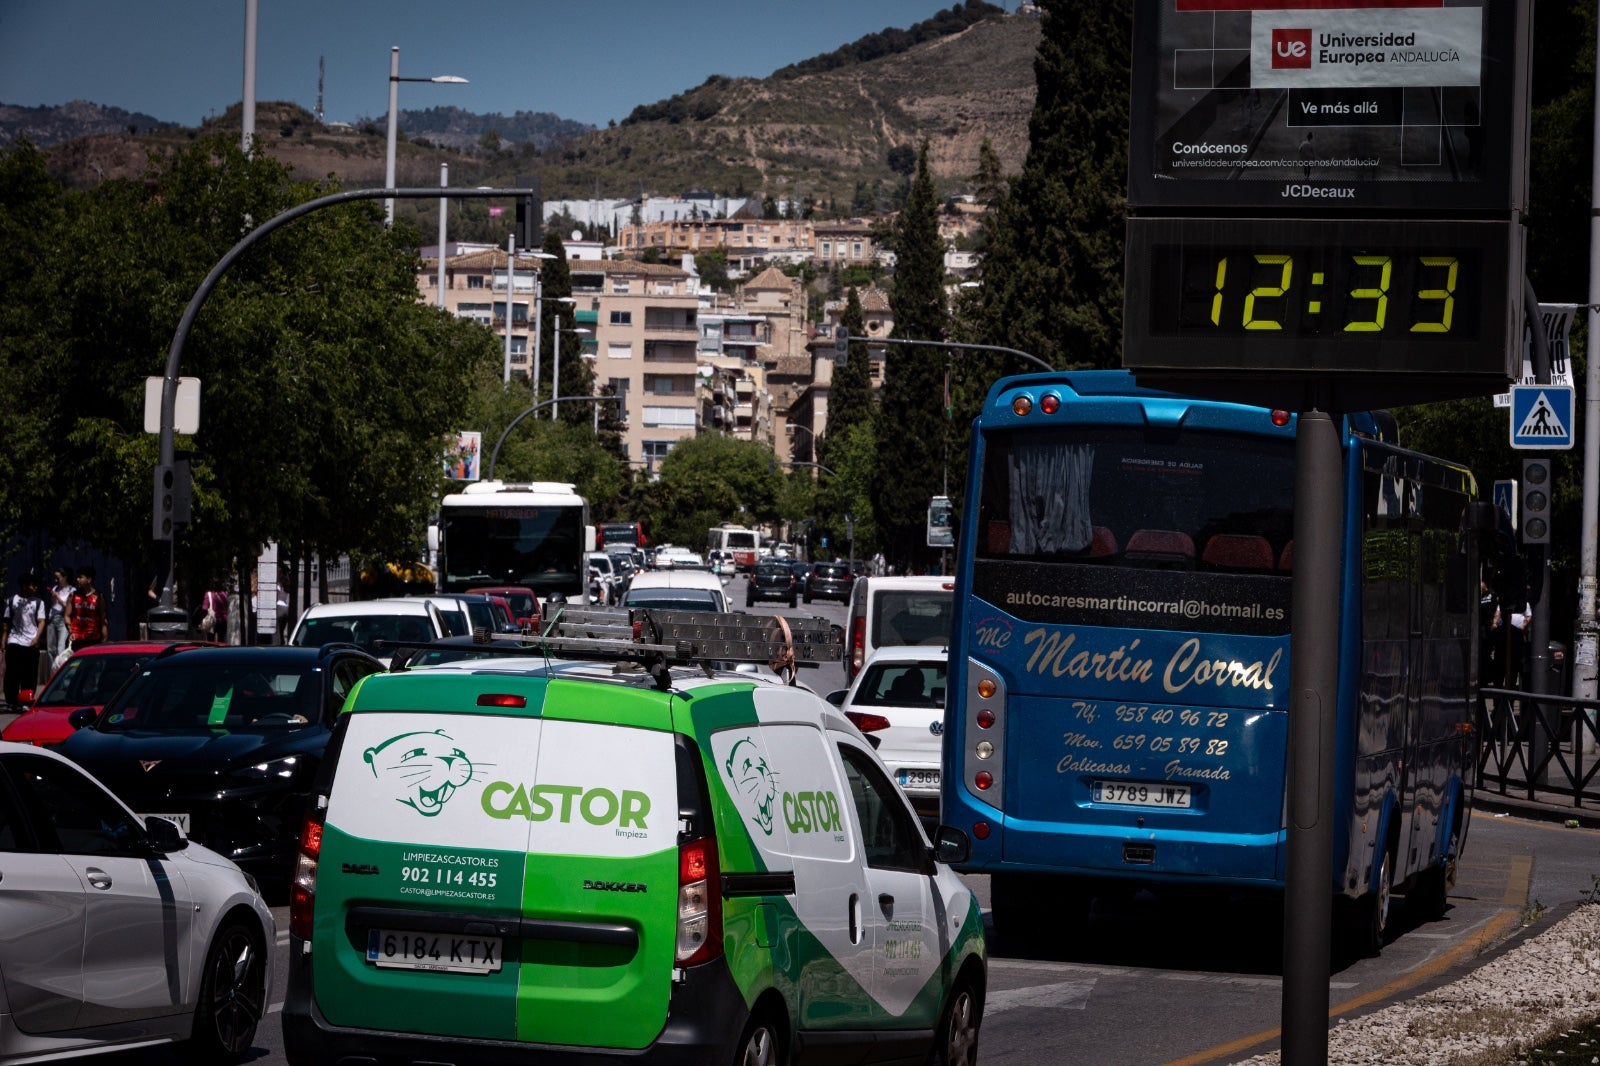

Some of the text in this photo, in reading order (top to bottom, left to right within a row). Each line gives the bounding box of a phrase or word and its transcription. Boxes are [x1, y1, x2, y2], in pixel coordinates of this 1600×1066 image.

[1277, 40, 1307, 58] ue
[1319, 32, 1416, 48] Universidad
[1319, 49, 1460, 67] Europea ANDALUCÍA
[1301, 100, 1378, 114] Ve más allá
[1172, 141, 1248, 155] Conócenos
[1280, 184, 1355, 198] JCDecaux
[1210, 254, 1458, 332] 12:33
[1006, 590, 1285, 620] autocaresmartincorral@hotmail.es
[1023, 628, 1283, 693] Martín Corral
[1115, 705, 1148, 723] 958
[1151, 709, 1174, 725] 40
[1180, 709, 1200, 726] 96
[1205, 712, 1228, 728] 72
[1113, 734, 1146, 751] 659
[1150, 736, 1171, 752] 05
[1177, 737, 1200, 754] 89
[1205, 739, 1228, 756] 82
[1056, 755, 1131, 775] Calicasas
[1164, 760, 1231, 781] Granada
[909, 772, 940, 784] 2960
[1105, 784, 1187, 805] 3789 JWZ
[480, 781, 652, 830] CASTOR
[782, 790, 843, 834] CASTOR
[615, 828, 648, 839] limpieza
[403, 852, 499, 868] LIMPIEZASCASTOR.ES
[402, 867, 497, 888] 902 114 455
[582, 878, 648, 894] DOKKER
[400, 887, 495, 900] CASTOR@LIMPIEZASCASTOR.ES
[384, 934, 496, 965] 6184 KTX
